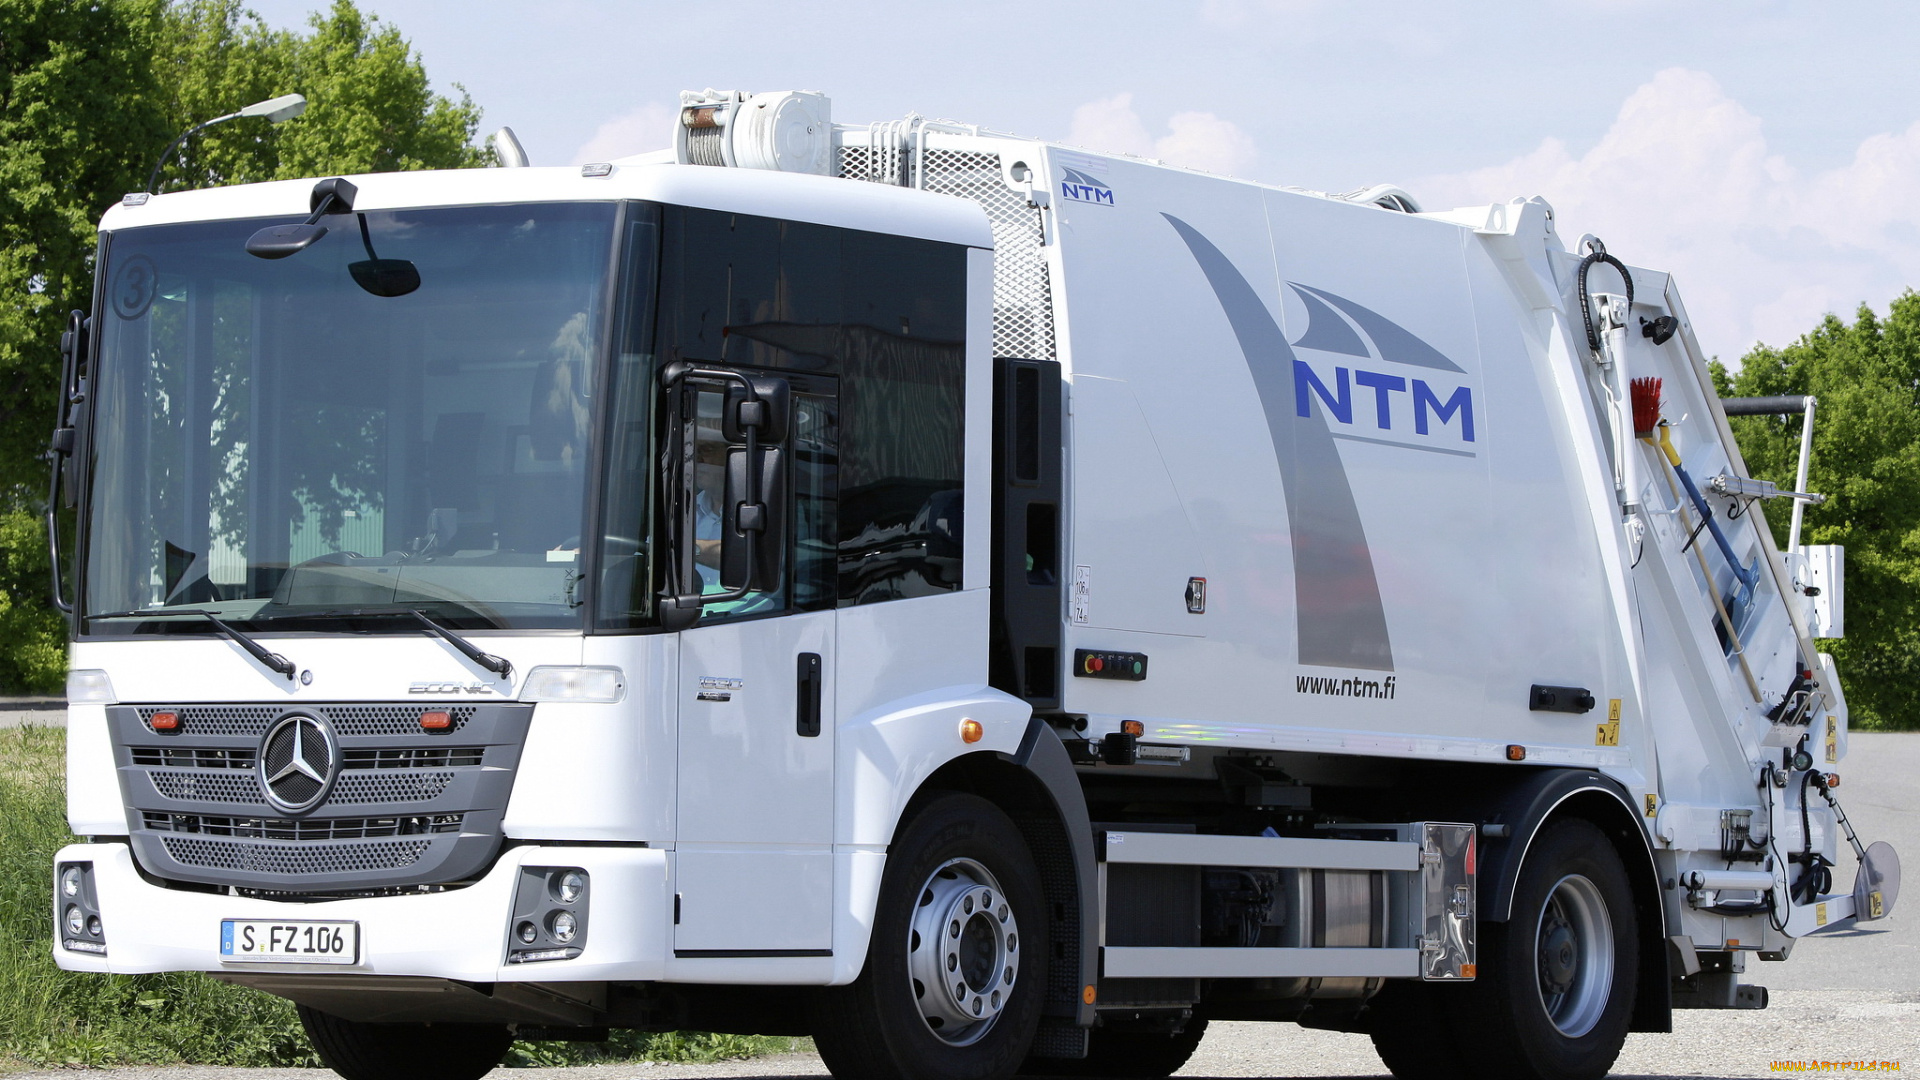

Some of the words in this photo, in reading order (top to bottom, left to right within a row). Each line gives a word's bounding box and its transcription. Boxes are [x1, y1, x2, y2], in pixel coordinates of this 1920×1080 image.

[1061, 182, 1114, 205] NTM
[123, 266, 145, 309] 3
[1293, 360, 1475, 442] NTM
[1296, 676, 1396, 699] www.ntm.fi
[242, 925, 255, 952] S
